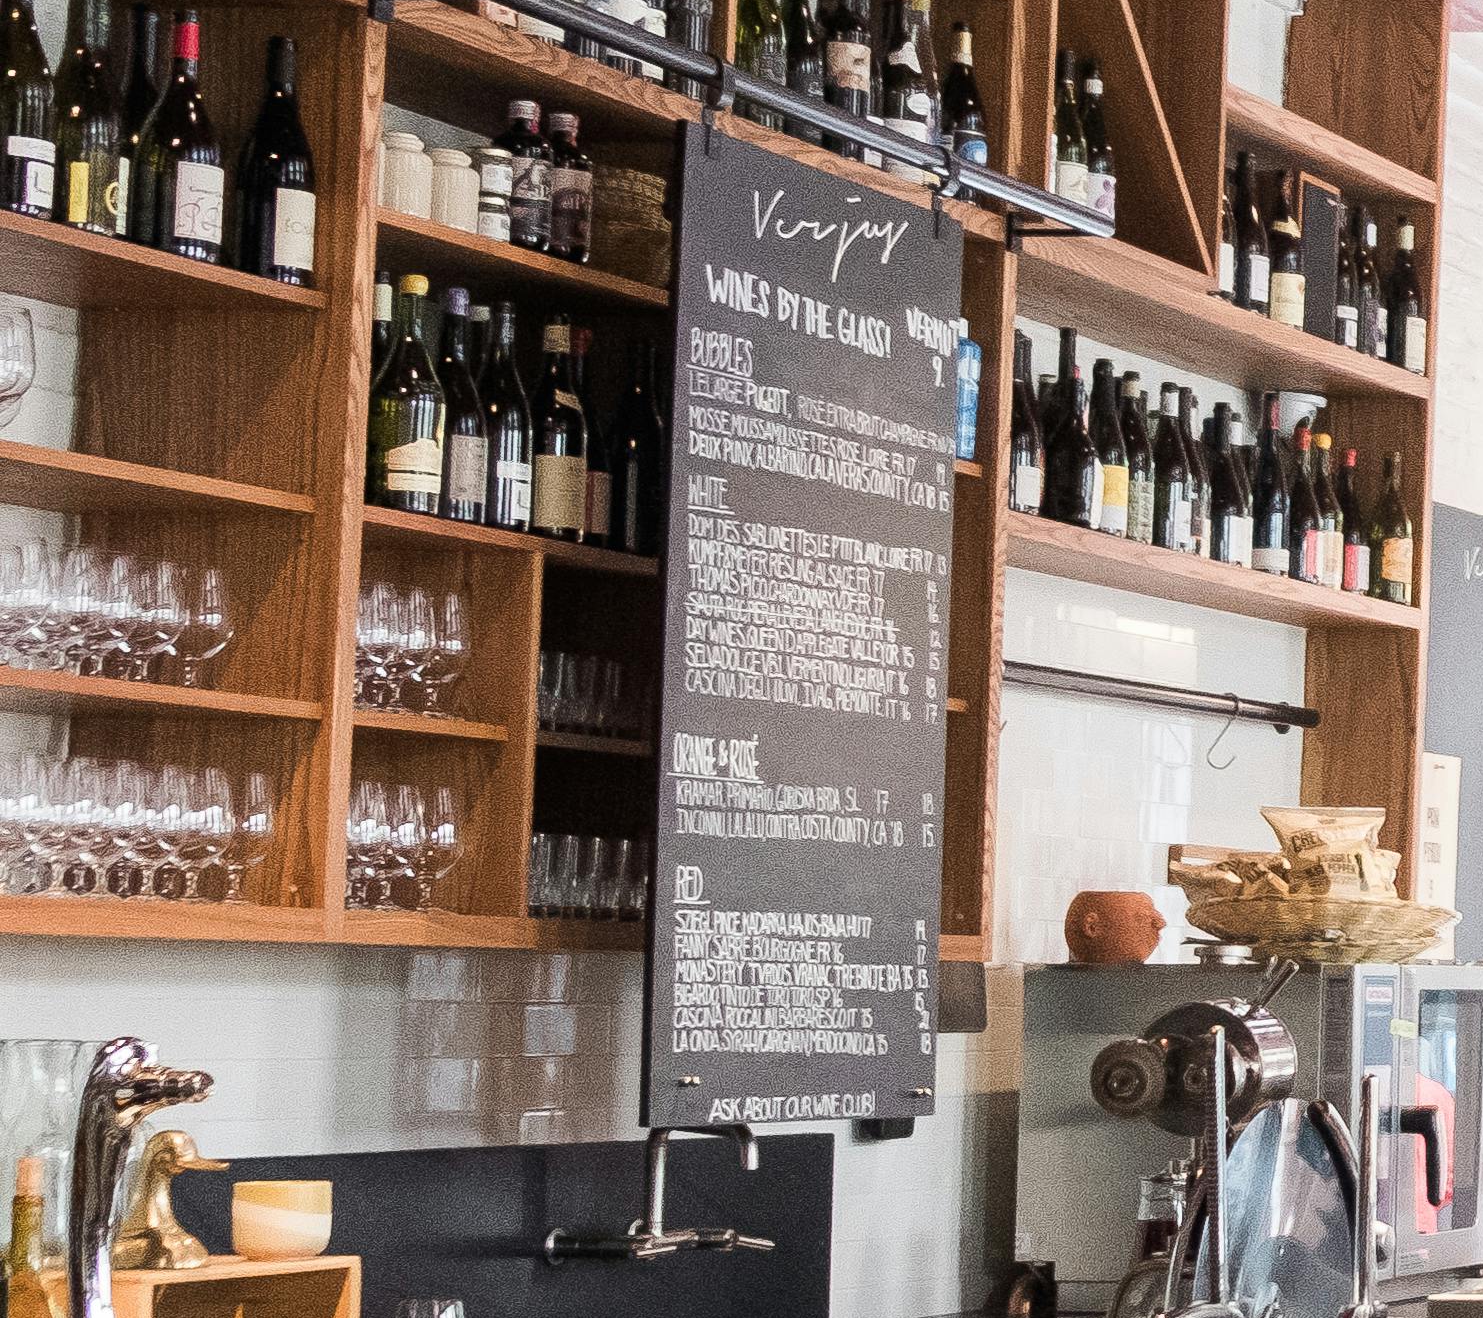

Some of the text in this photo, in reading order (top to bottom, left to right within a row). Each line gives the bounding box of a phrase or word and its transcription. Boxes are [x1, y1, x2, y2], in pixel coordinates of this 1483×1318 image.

[705, 264, 892, 359] WINES BY THE GLASS!
[690, 327, 754, 377] BUBBLES
[688, 405, 732, 435] MOSSE
[688, 433, 722, 460] DEUX
[687, 474, 730, 510] WHITE
[687, 512, 716, 538] DOM
[717, 518, 741, 543] DES
[687, 563, 740, 596] THOMAS
[685, 668, 738, 699] CASCINA
[673, 732, 716, 776] ORANGE
[718, 739, 729, 767] &
[872, 820, 888, 846] CA
[676, 865, 704, 901] RED
[674, 934, 712, 960] FANNY
[674, 959, 743, 985] MONASTERY
[674, 1006, 724, 1029] CASCINA
[674, 1029, 689, 1053] LA
[690, 1029, 720, 1052] ONDA
[708, 1091, 876, 1123] ASK ABOUT OUR WINE CLUB!
